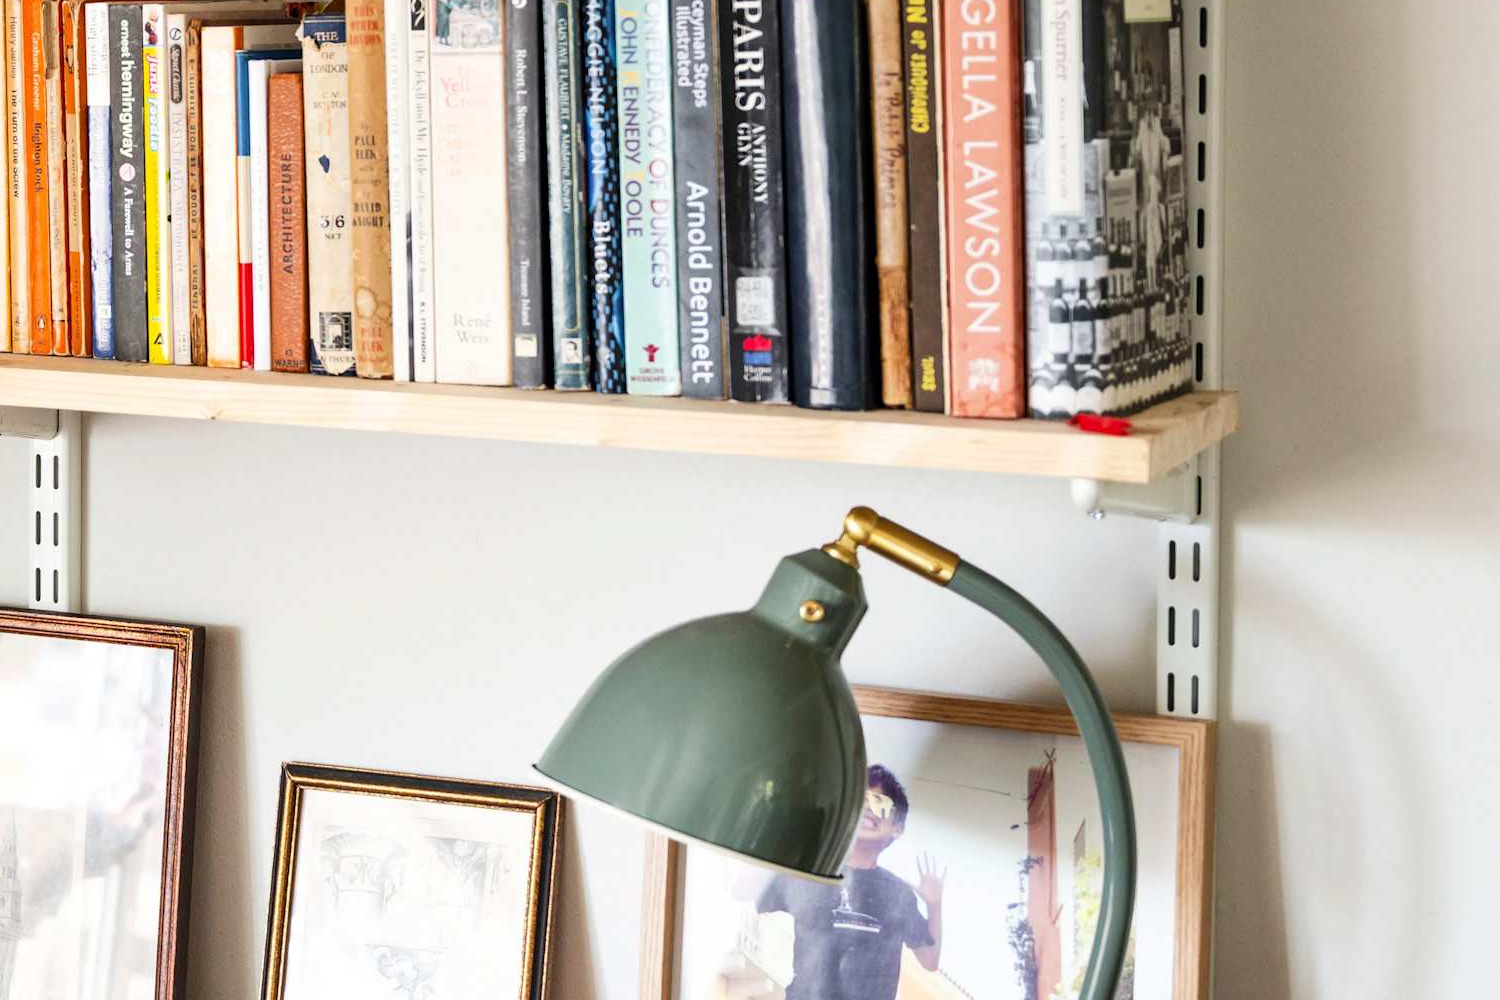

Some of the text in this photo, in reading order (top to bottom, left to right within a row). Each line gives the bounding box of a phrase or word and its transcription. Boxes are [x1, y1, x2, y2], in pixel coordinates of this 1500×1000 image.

[309, 64, 348, 75] LONDON
[675, 5, 692, 88] Illustrated
[693, 62, 710, 109] Steps
[117, 57, 136, 159] hemingway
[590, 86, 607, 176] NELSON
[283, 153, 293, 274] ARCHITECTURE
[962, 139, 1001, 334] LAWSON
[685, 180, 713, 385] Arnold Bennett
